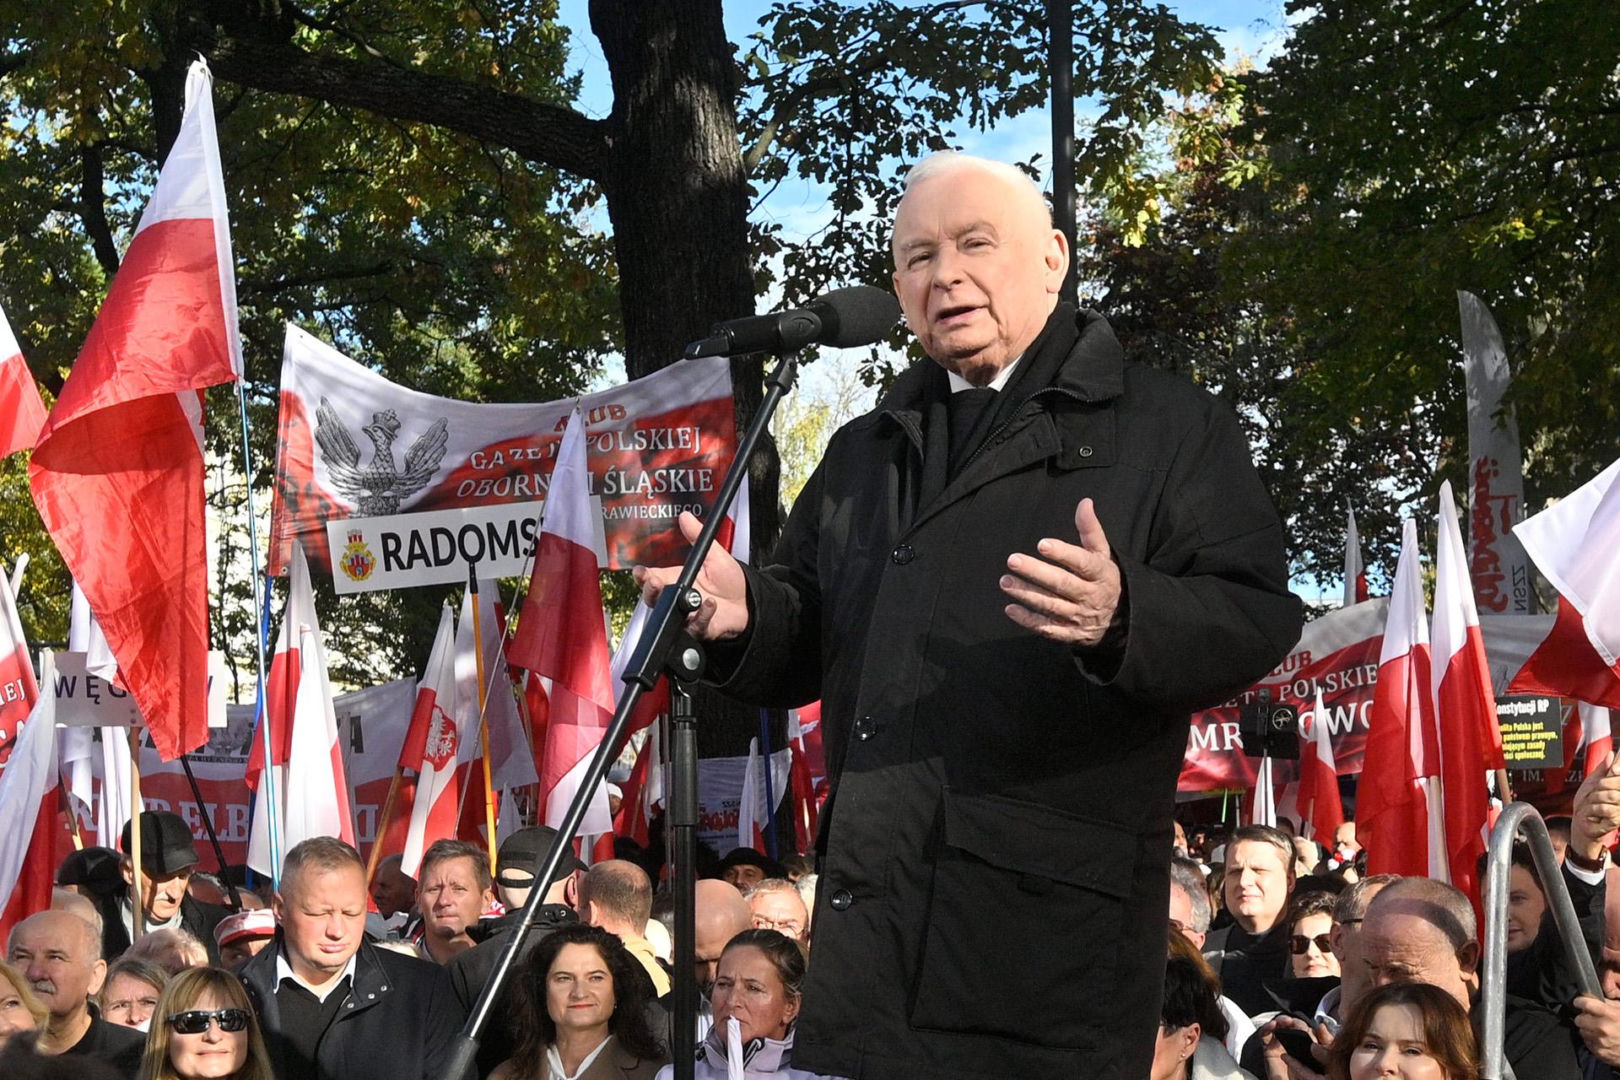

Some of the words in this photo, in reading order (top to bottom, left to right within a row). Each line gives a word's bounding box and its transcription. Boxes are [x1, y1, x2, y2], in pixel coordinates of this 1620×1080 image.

[603, 465, 713, 499] ŚLĄSKIE
[602, 503, 702, 520] RAWIECKIEGO
[381, 517, 544, 572] RADOMS
[1280, 664, 1378, 702] POLSKIE
[1496, 700, 1536, 717] onstytucji
[1537, 699, 1549, 713] RP
